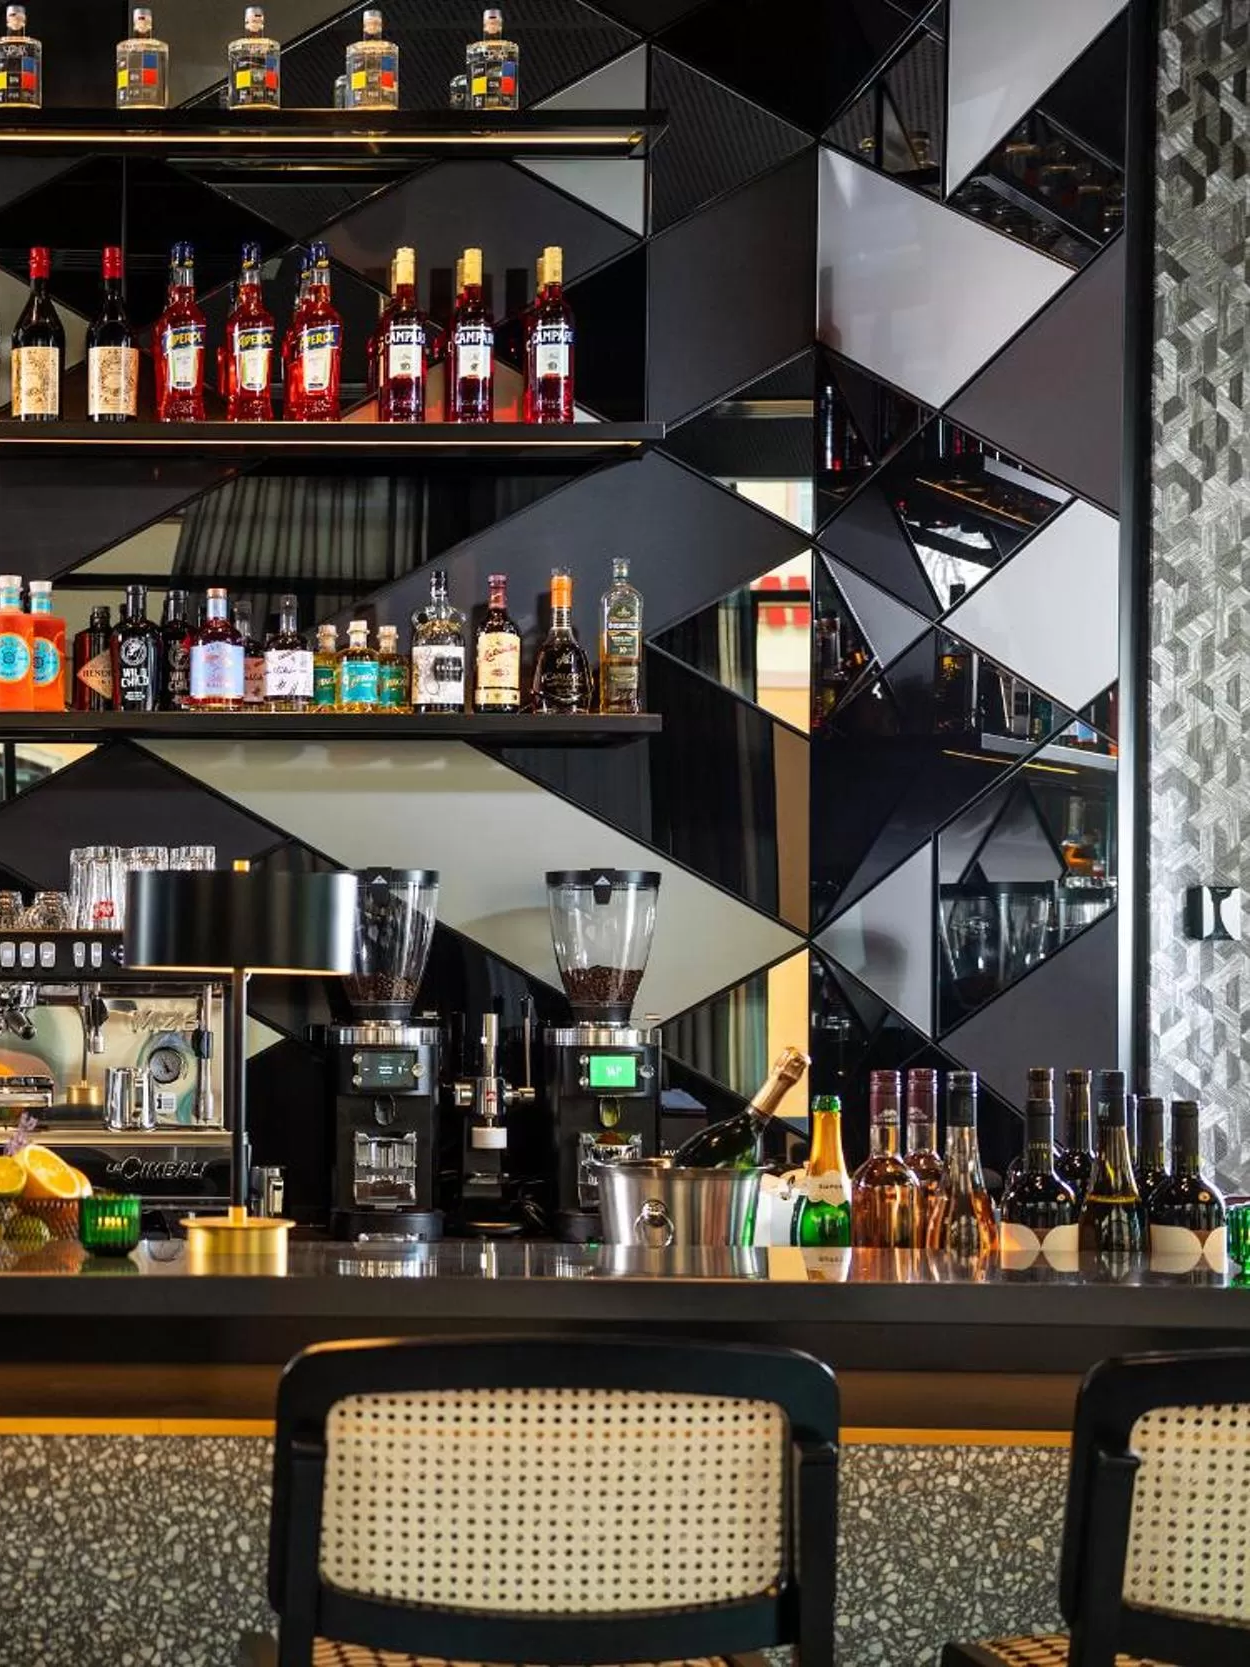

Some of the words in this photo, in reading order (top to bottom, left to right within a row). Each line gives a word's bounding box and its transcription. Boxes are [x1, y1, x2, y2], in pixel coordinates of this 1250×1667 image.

[169, 331, 201, 346] APEROL
[238, 333, 272, 347] APEROL
[300, 331, 334, 348] APEROL
[385, 332, 425, 344] CAMPARI
[455, 332, 494, 344] CAMPARI
[532, 331, 574, 344] CAMPARI
[123, 668, 147, 677] WILD
[121, 677, 149, 688] CHILD
